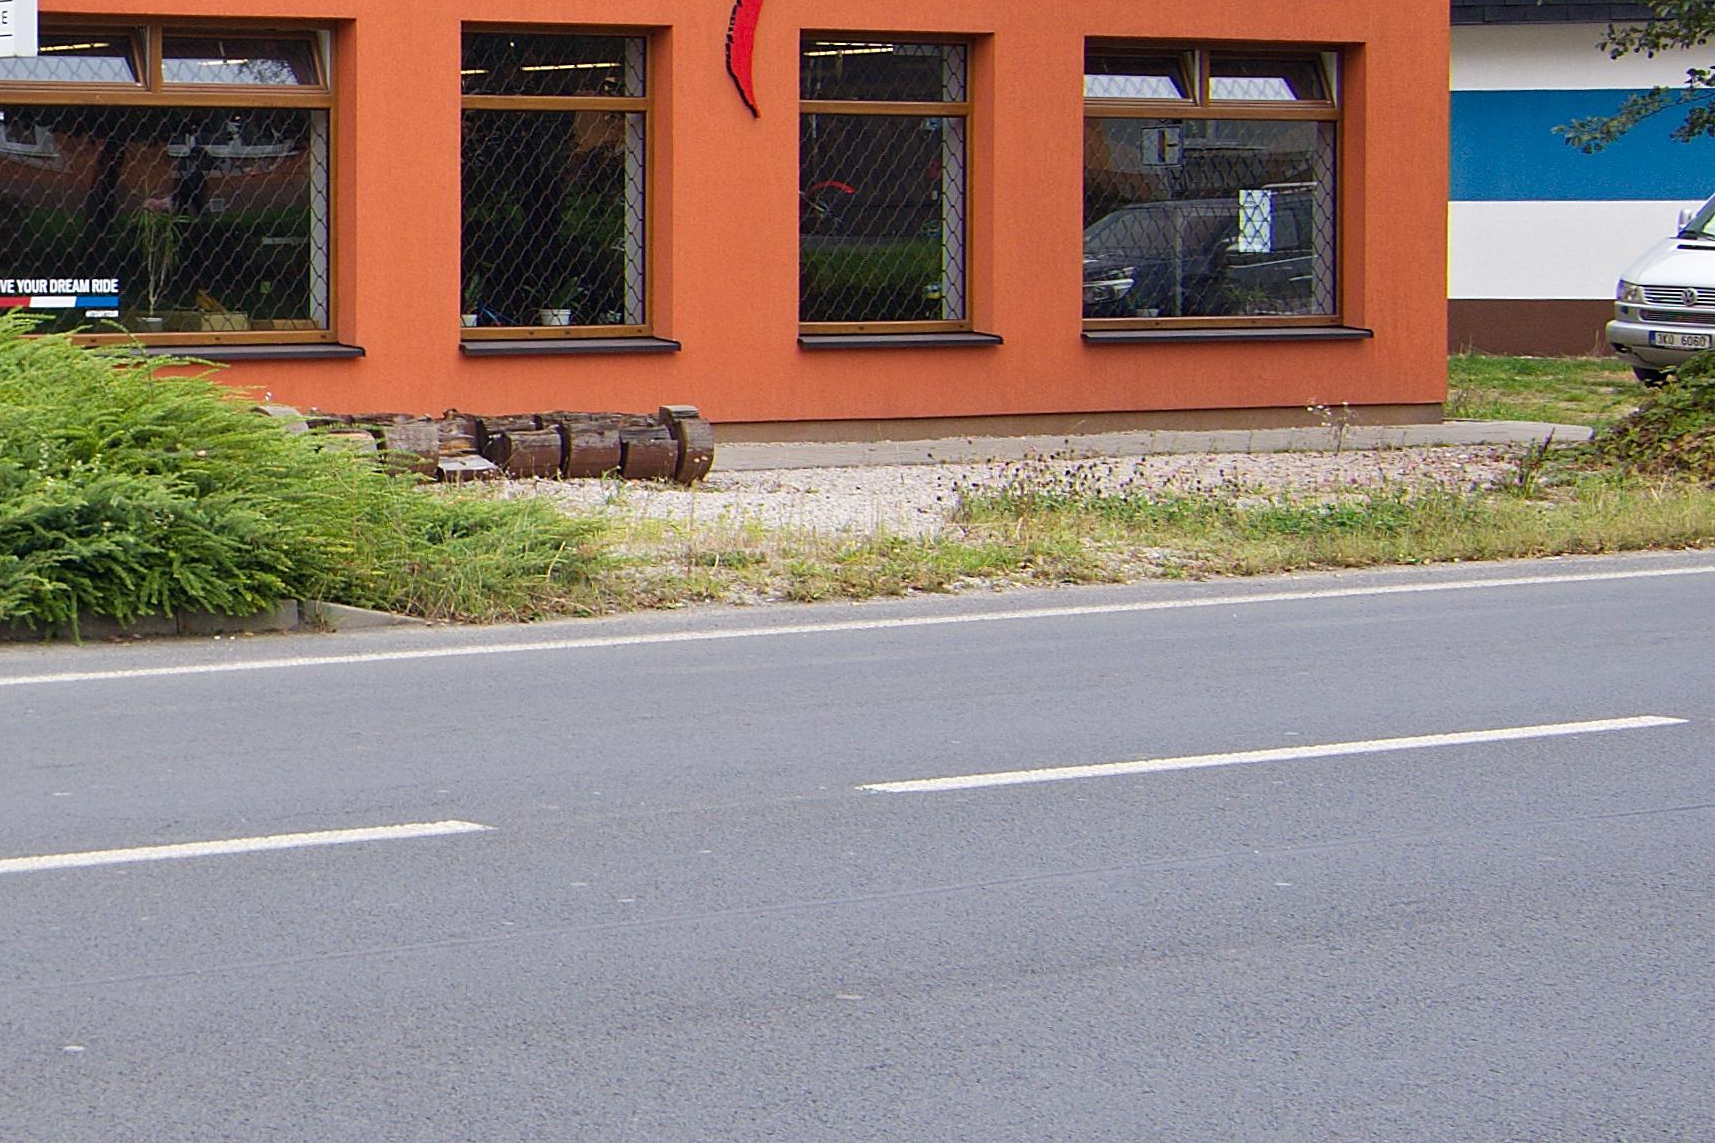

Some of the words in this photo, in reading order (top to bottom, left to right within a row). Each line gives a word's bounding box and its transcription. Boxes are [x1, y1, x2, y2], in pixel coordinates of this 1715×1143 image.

[16, 279, 48, 293] YOUR
[49, 279, 90, 293] DREAM
[91, 279, 119, 293] RIDE
